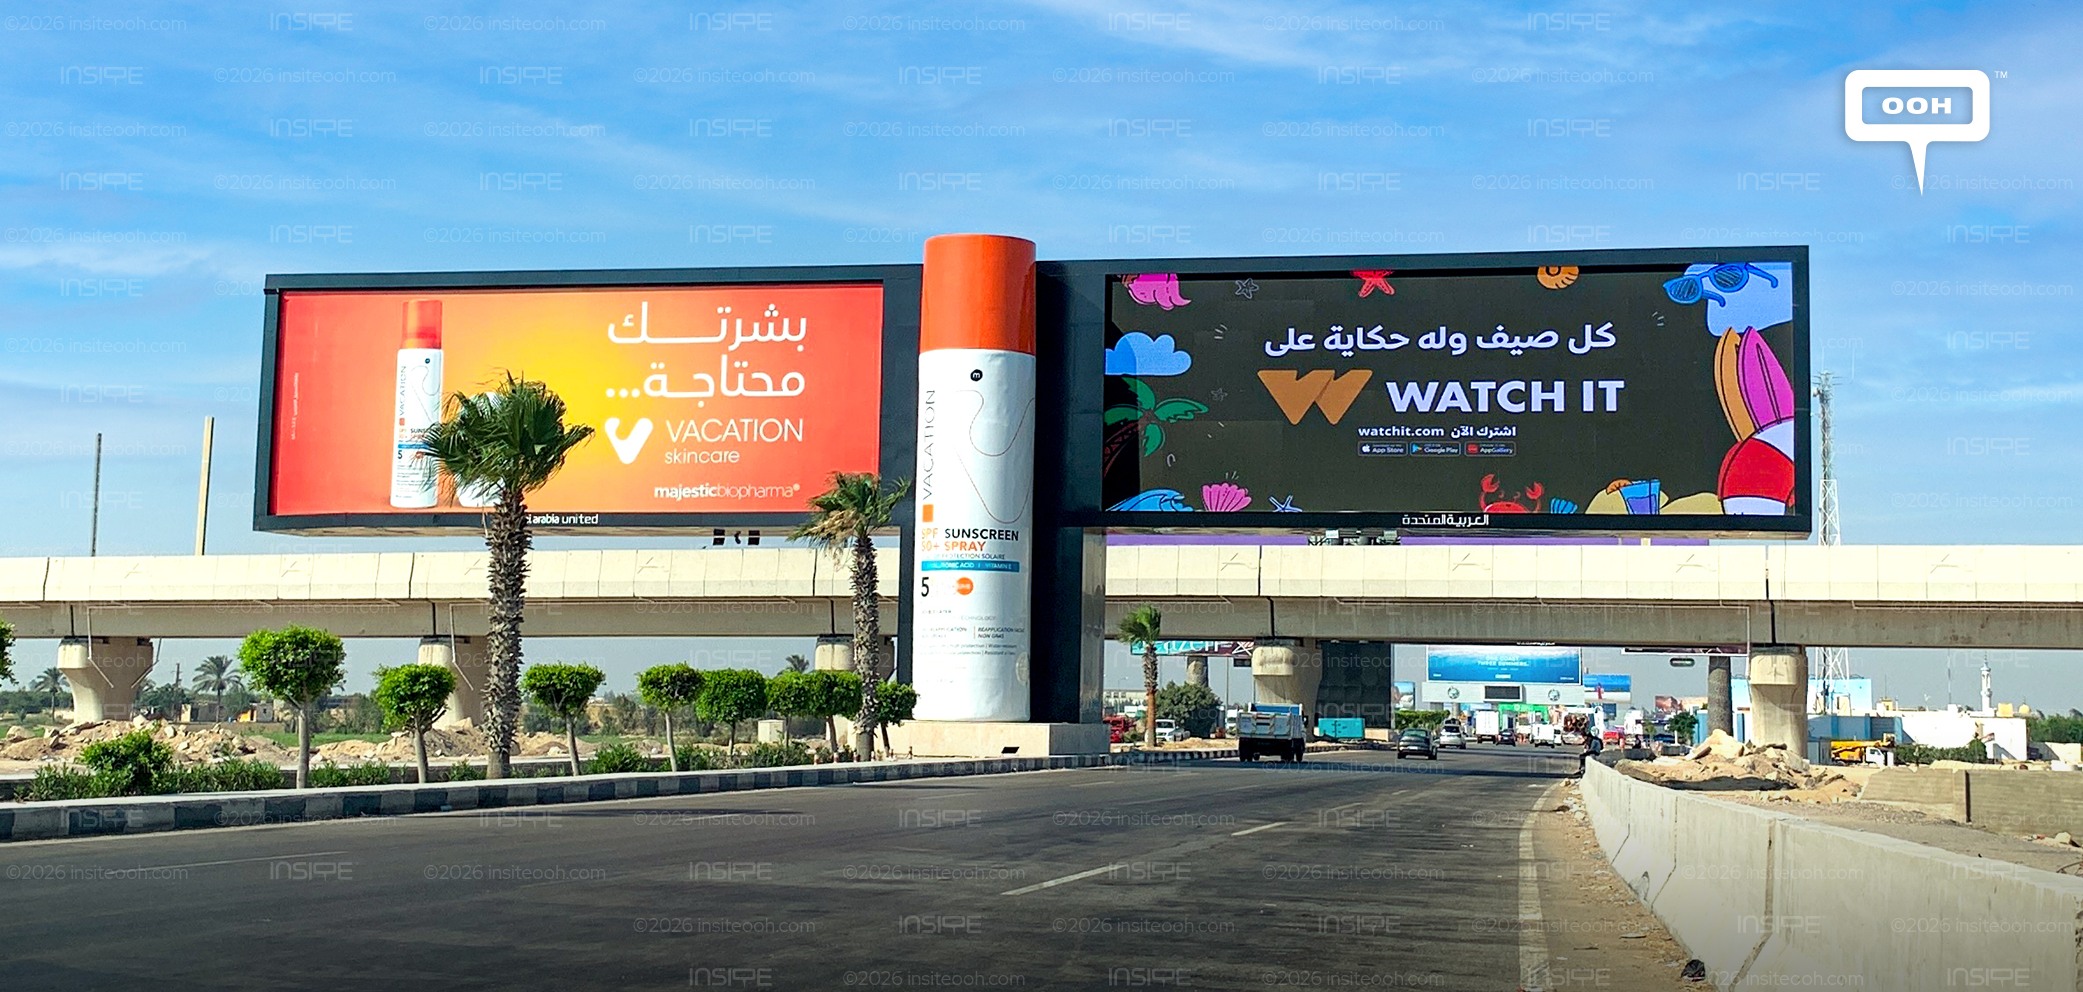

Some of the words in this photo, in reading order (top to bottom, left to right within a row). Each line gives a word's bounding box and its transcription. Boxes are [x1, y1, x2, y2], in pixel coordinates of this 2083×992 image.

[1264, 328, 1315, 357] على
[1323, 325, 1410, 357] حكاية
[1418, 326, 1467, 354] وله
[1476, 325, 1559, 357] صيف
[1567, 321, 1617, 354] كل
[399, 365, 407, 416] VACATION
[1386, 380, 1566, 413] WATCH
[1582, 380, 1625, 412] IT
[665, 418, 804, 443] VACATION
[1358, 425, 1445, 437] watchit.com
[1476, 425, 1517, 439] اشترك
[664, 448, 740, 464] skincare
[922, 390, 936, 501] VACATION
[561, 513, 599, 524] united
[921, 541, 940, 552] 50+
[944, 541, 986, 552] SPRAY
[922, 528, 938, 539] SPF
[944, 528, 1020, 541] SUNSCREEN
[921, 576, 930, 597] 5
